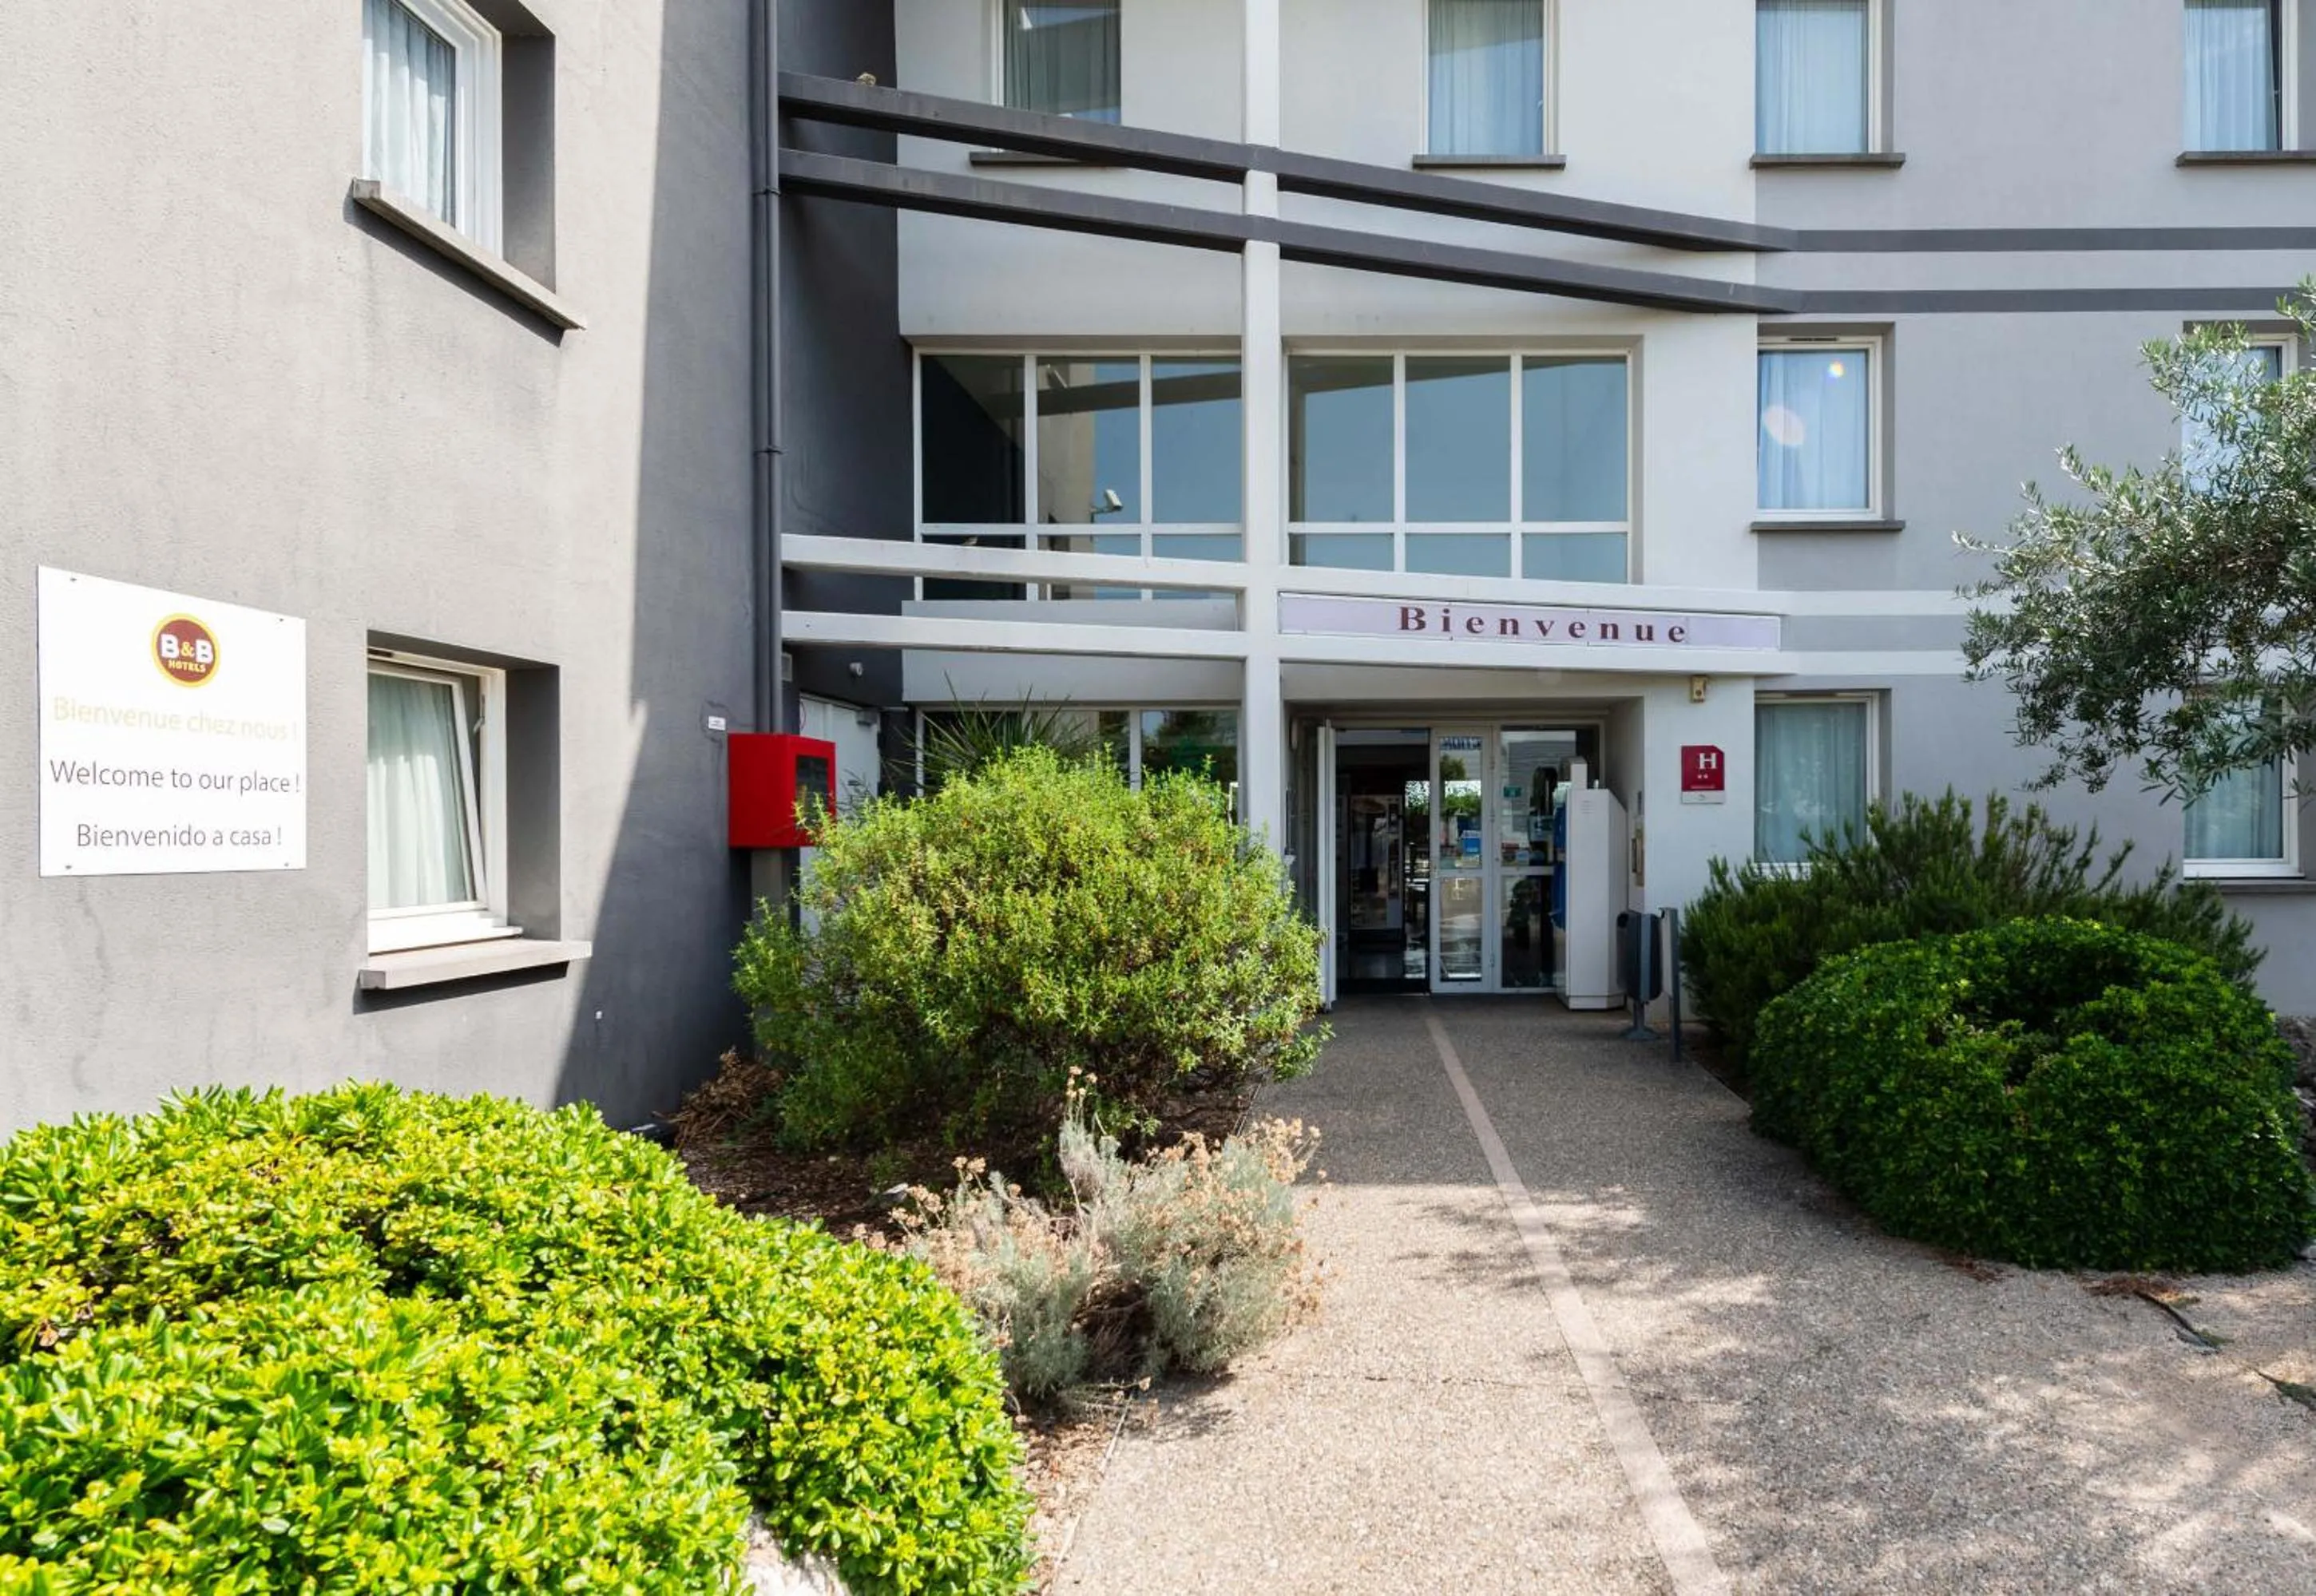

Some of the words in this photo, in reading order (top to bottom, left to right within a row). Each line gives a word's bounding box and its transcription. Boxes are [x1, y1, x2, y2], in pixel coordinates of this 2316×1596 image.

[1398, 605, 1685, 643] Bienvenue
[161, 633, 213, 663] B&B
[168, 659, 206, 673] HOTELS
[54, 695, 183, 731] Bienvenue
[187, 708, 236, 736] chez
[1699, 752, 1716, 770] H
[50, 759, 165, 788] Welcome
[170, 768, 192, 789] to
[198, 773, 234, 790] our
[240, 770, 291, 796] place
[77, 823, 207, 847] Bienvenido
[212, 830, 224, 846] a
[229, 830, 272, 846] casa
